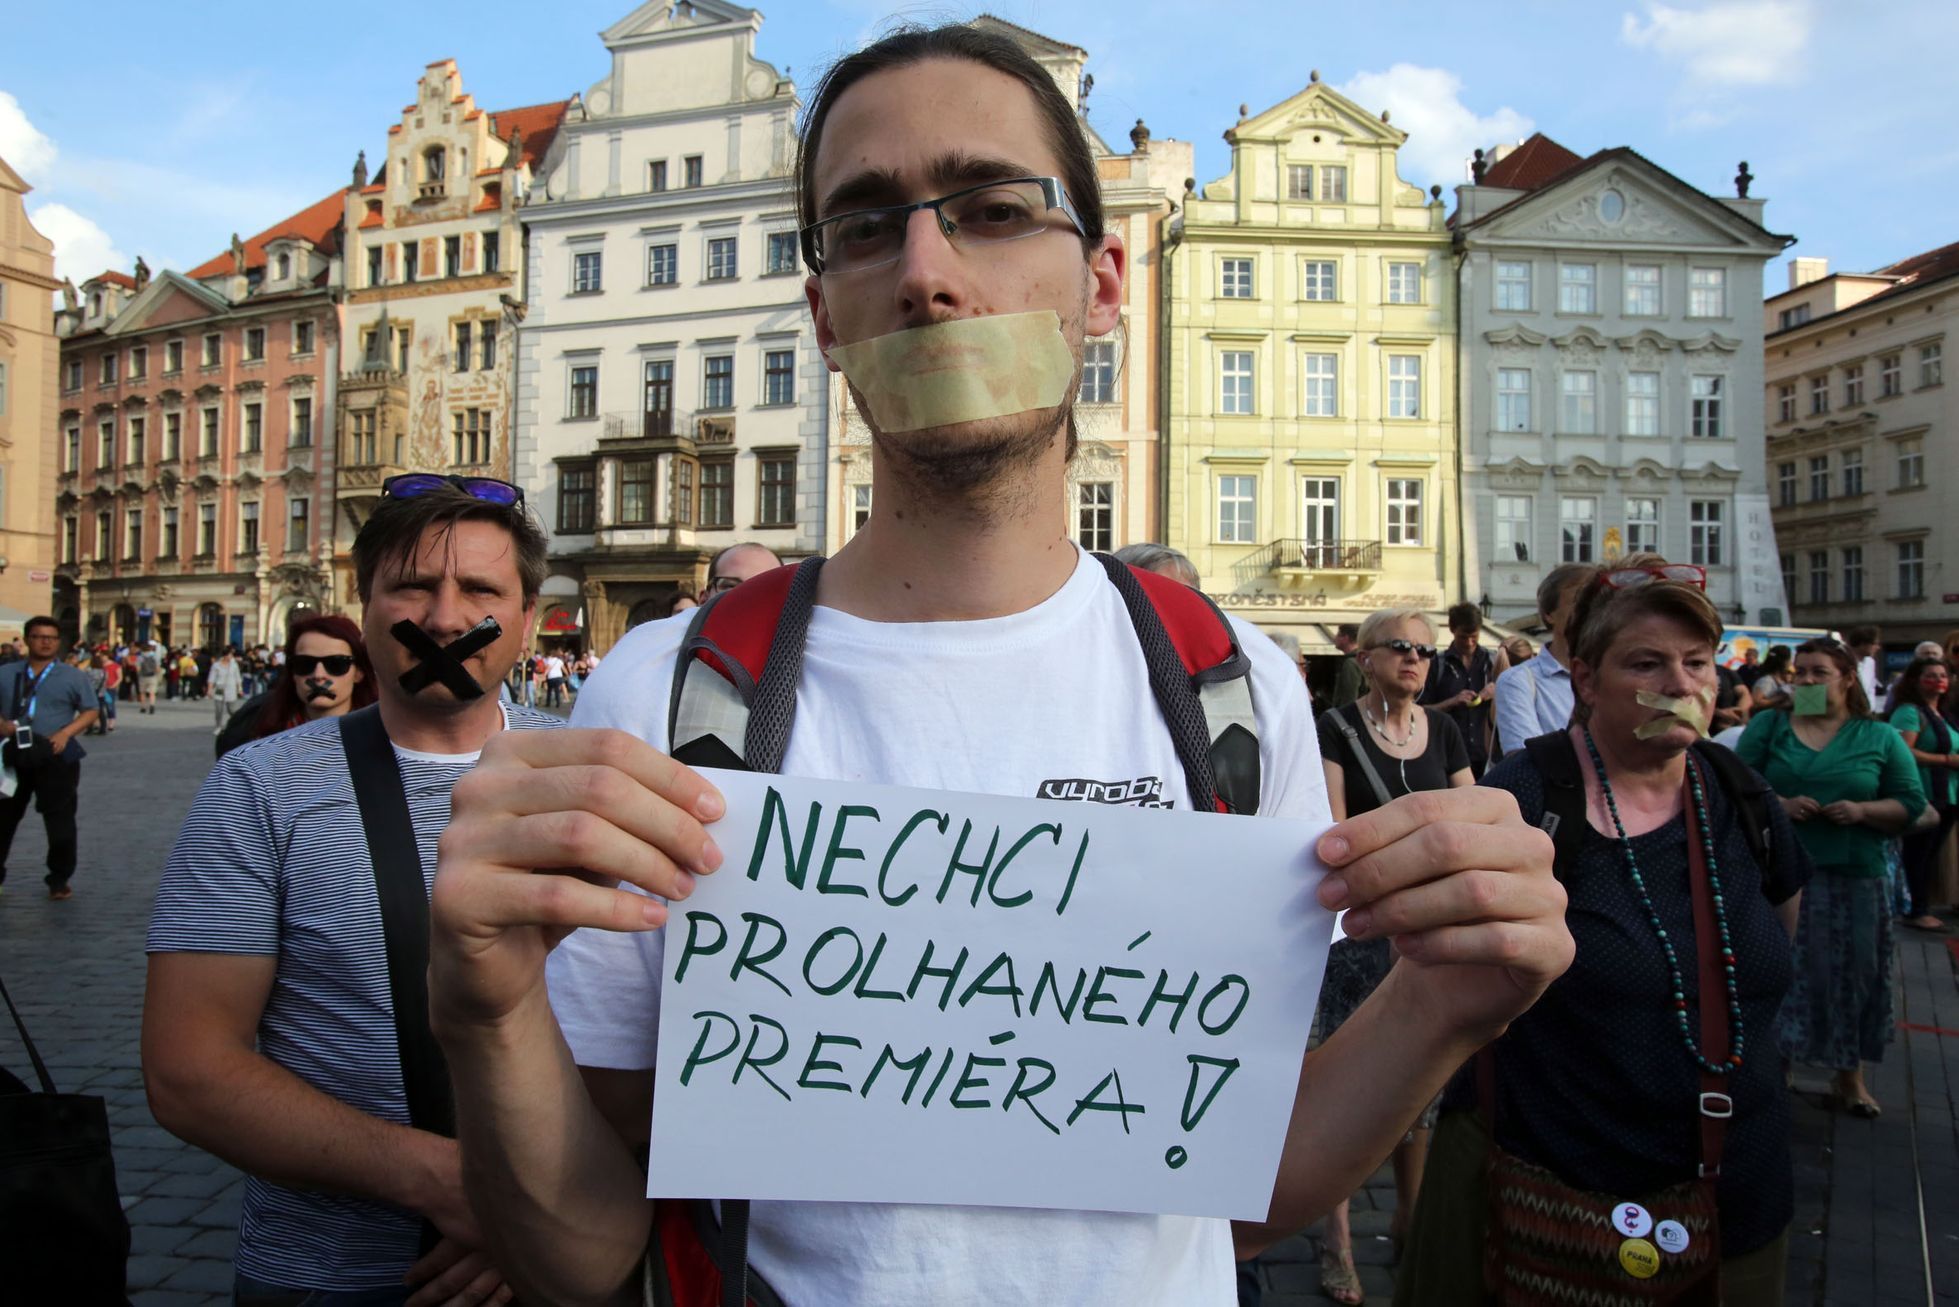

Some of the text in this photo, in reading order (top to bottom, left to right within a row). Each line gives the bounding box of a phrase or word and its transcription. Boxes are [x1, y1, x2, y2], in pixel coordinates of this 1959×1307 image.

[1748, 512, 1763, 594] HOTEL
[1207, 588, 1327, 606] ROMĚSTSKÁ
[747, 786, 1089, 915] NECHCI
[675, 911, 1250, 1036] PROLHANÉHO
[1626, 1250, 1653, 1265] PRAHA
